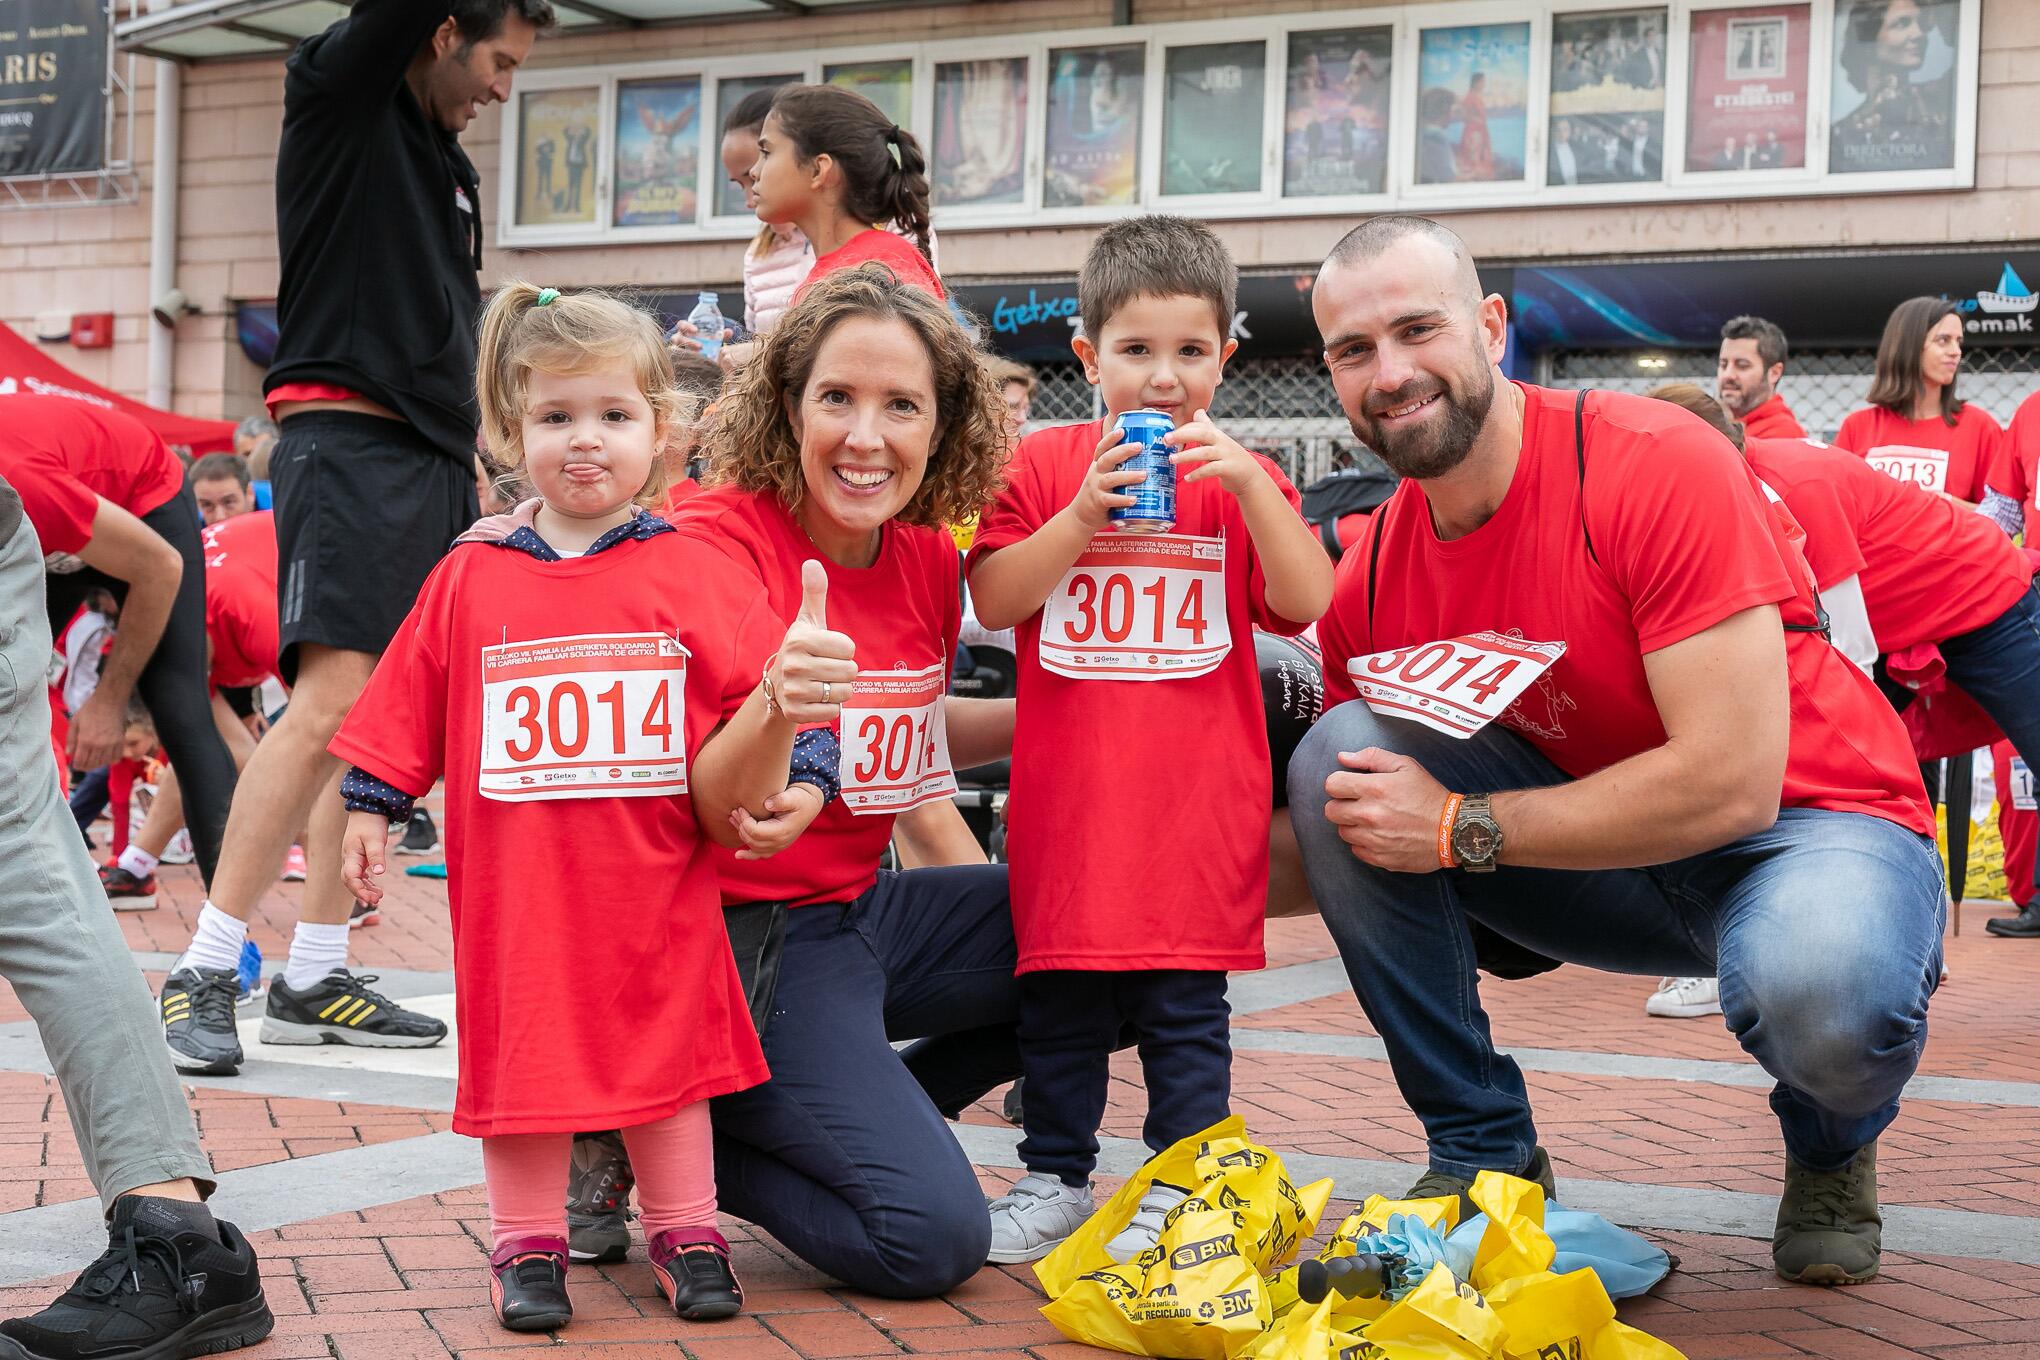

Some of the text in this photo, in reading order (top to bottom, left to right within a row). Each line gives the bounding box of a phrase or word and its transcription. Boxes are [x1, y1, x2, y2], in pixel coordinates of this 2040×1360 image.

[993, 289, 1079, 334] Getxo
[1966, 314, 2034, 333] emak
[1064, 573, 1208, 644] 3014
[487, 652, 520, 662] GETXOKO
[532, 647, 560, 656] FAMILIA
[560, 644, 608, 652] LASTERKETA
[498, 658, 532, 668] CARRERA
[534, 653, 569, 662] FAMILIAR
[570, 650, 613, 658] SOLIDARIA
[1368, 643, 1521, 704] 3014
[1278, 660, 1294, 712] begisare
[1292, 660, 1310, 720] BIZKAIA
[505, 680, 672, 762] 3014
[854, 712, 935, 783] 3014
[1200, 1238, 1234, 1260] BM
[1146, 1308, 1191, 1320] RECICLADO
[1222, 1292, 1254, 1316] BM
